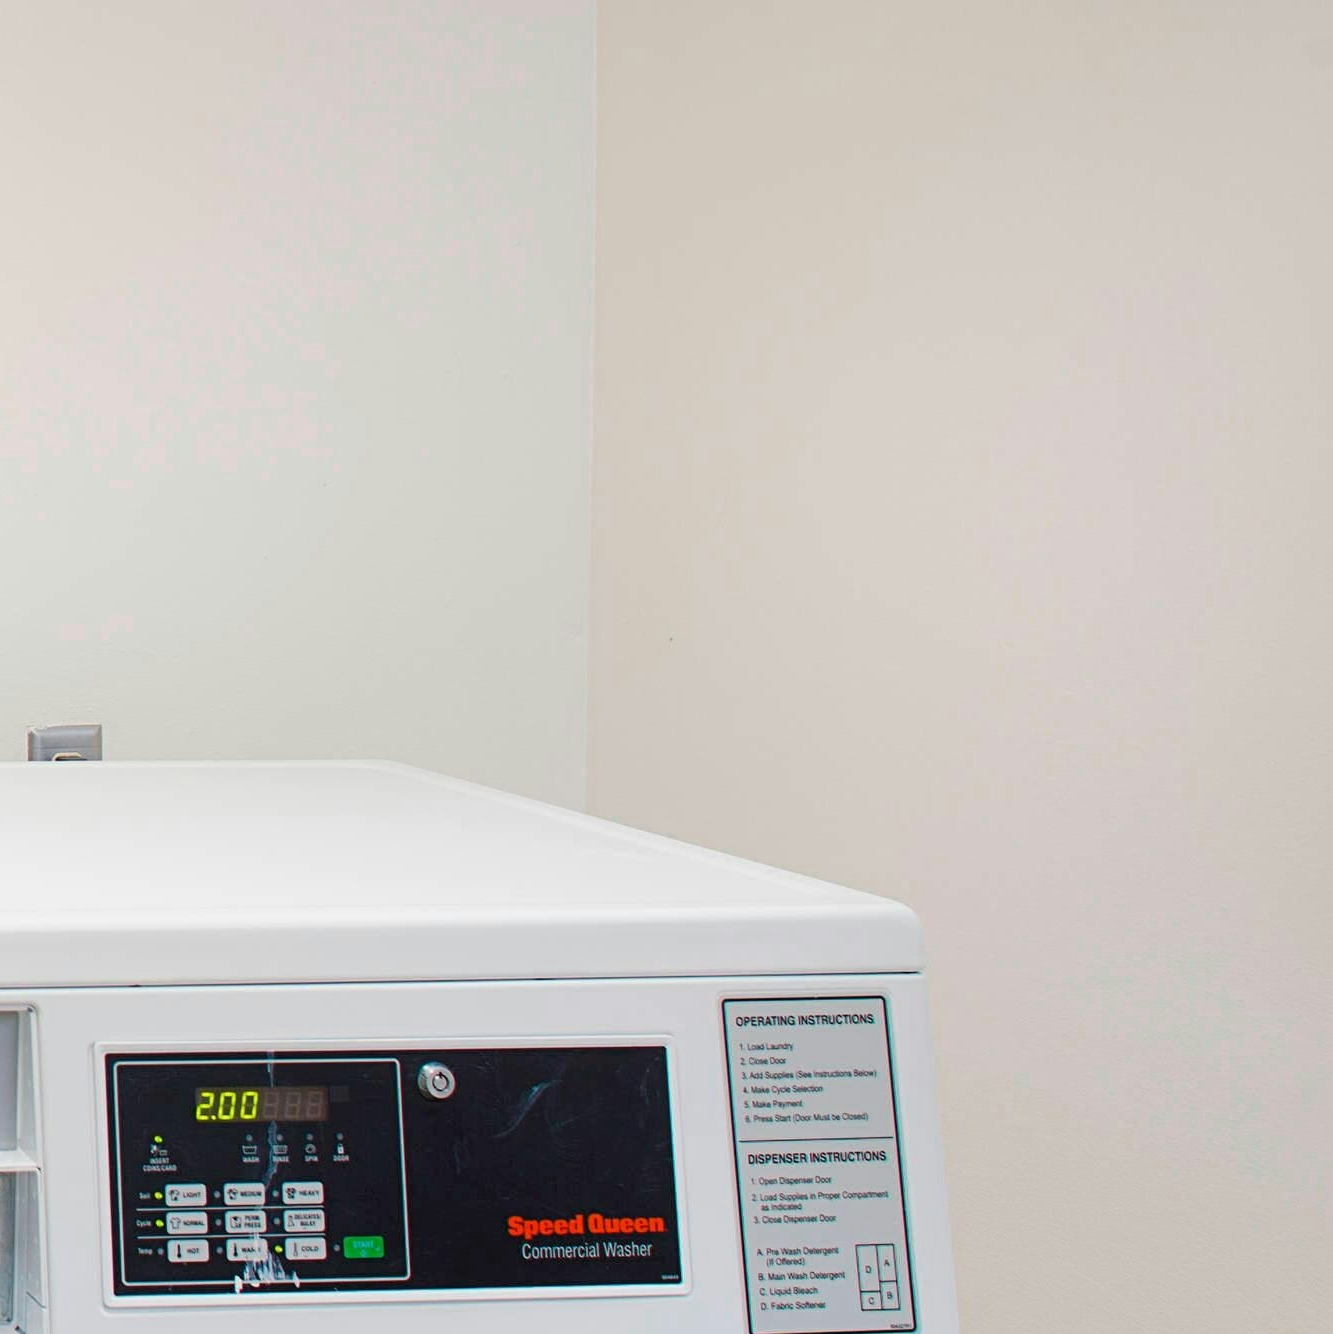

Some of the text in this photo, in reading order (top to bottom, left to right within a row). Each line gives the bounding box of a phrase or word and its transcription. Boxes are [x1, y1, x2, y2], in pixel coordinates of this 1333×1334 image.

[736, 1013, 875, 1027] OPERATING INSTRUCTIONS
[747, 1043, 765, 1051] Load
[766, 1042, 794, 1051] Laundry
[748, 1057, 768, 1065] Close
[769, 1056, 787, 1065] Door
[749, 1072, 764, 1080] Add
[764, 1071, 794, 1081] Supplies
[813, 1069, 852, 1078] Instructions
[853, 1069, 877, 1078] Below)
[751, 1086, 770, 1094] Make
[771, 1085, 791, 1096] Cycle
[792, 1084, 823, 1093] Selection
[196, 1091, 259, 1121] 2.00
[752, 1100, 772, 1109] Make
[773, 1099, 803, 1110] Payment
[753, 1115, 773, 1123] Press
[774, 1114, 791, 1122] Start
[813, 1113, 830, 1121] Must
[832, 1113, 840, 1121] be
[842, 1112, 869, 1122] Closed)
[748, 1151, 887, 1165] DISPENSER INSTRUCTIONS
[758, 1177, 778, 1187] Open
[779, 1176, 814, 1186] Dispenser
[815, 1175, 832, 1184] Door
[760, 1193, 777, 1202] Load
[778, 1192, 808, 1202] Supplies
[810, 1192, 817, 1200] in
[818, 1191, 841, 1201] Proper
[842, 1190, 889, 1200] Compartment
[762, 1216, 782, 1224] Close
[783, 1215, 818, 1225] Dispenser
[819, 1214, 836, 1222] Door
[507, 1213, 665, 1240] Speed Queen
[352, 1240, 374, 1248] START
[522, 1242, 652, 1260] Commercial Washer
[803, 1246, 839, 1257] Detergent
[883, 1259, 891, 1267] A
[865, 1265, 872, 1274] D
[767, 1272, 786, 1281] Main
[787, 1271, 808, 1280] Wash
[810, 1271, 845, 1281] Detergent
[769, 1287, 792, 1297] Liquid
[793, 1286, 818, 1295] Bleach
[886, 1291, 894, 1300] B
[771, 1302, 794, 1310] Fabric
[795, 1301, 826, 1310] Softener
[868, 1296, 875, 1305] C
